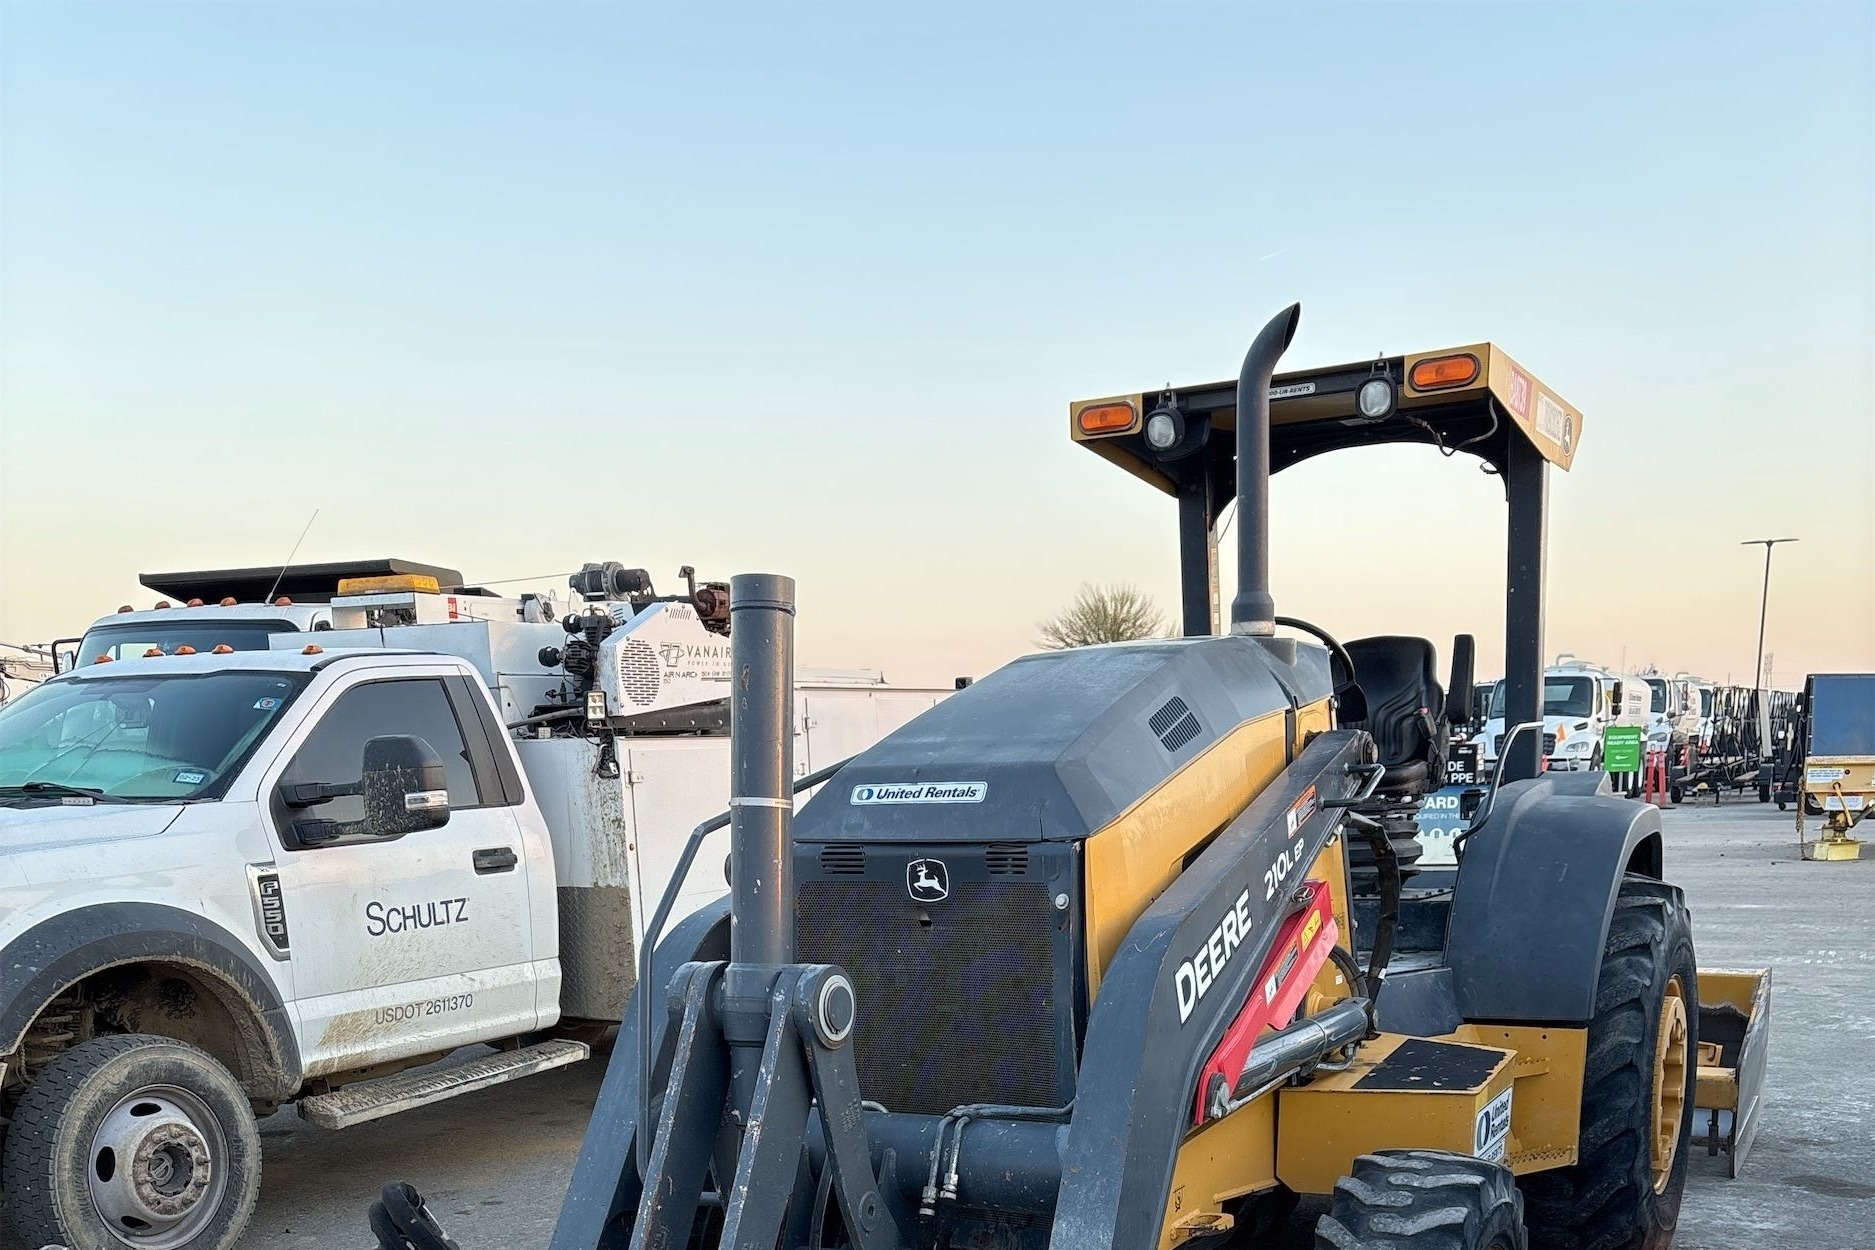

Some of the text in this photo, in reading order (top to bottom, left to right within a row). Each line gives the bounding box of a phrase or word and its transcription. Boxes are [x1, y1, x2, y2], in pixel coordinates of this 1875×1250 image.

[876, 786, 978, 800] United Rentals
[1450, 773, 1474, 783] PPE
[1424, 796, 1459, 809] ARD
[1264, 850, 1294, 902] 210L
[1294, 838, 1305, 862] EP
[366, 898, 468, 936] SCHULTZ
[1175, 888, 1252, 1025] DEERE
[375, 993, 473, 1025] USDOT 2611370
